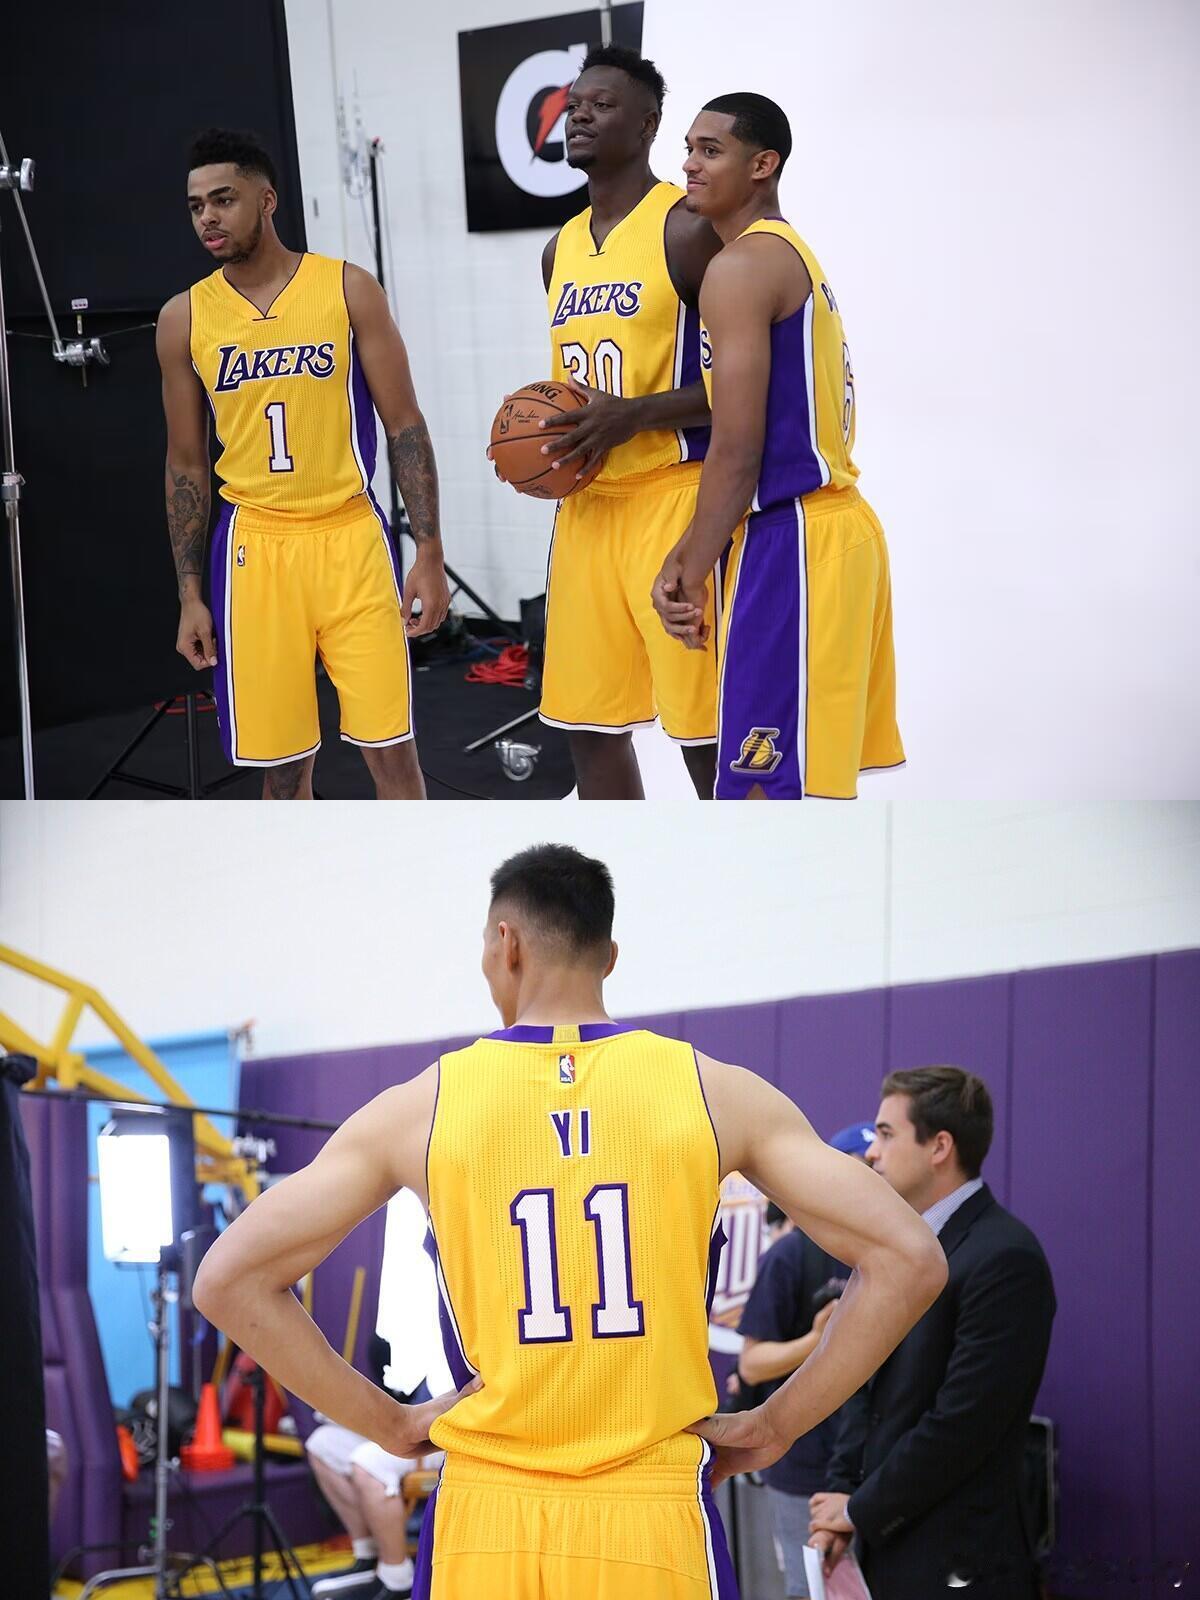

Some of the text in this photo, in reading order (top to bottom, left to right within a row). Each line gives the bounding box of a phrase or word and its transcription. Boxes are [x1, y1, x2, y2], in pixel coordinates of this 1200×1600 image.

[550, 281, 643, 328] LAKERS
[214, 342, 336, 393] LAKERS
[264, 401, 295, 473] 1
[549, 1108, 591, 1158] YI
[509, 1182, 645, 1345] 11
